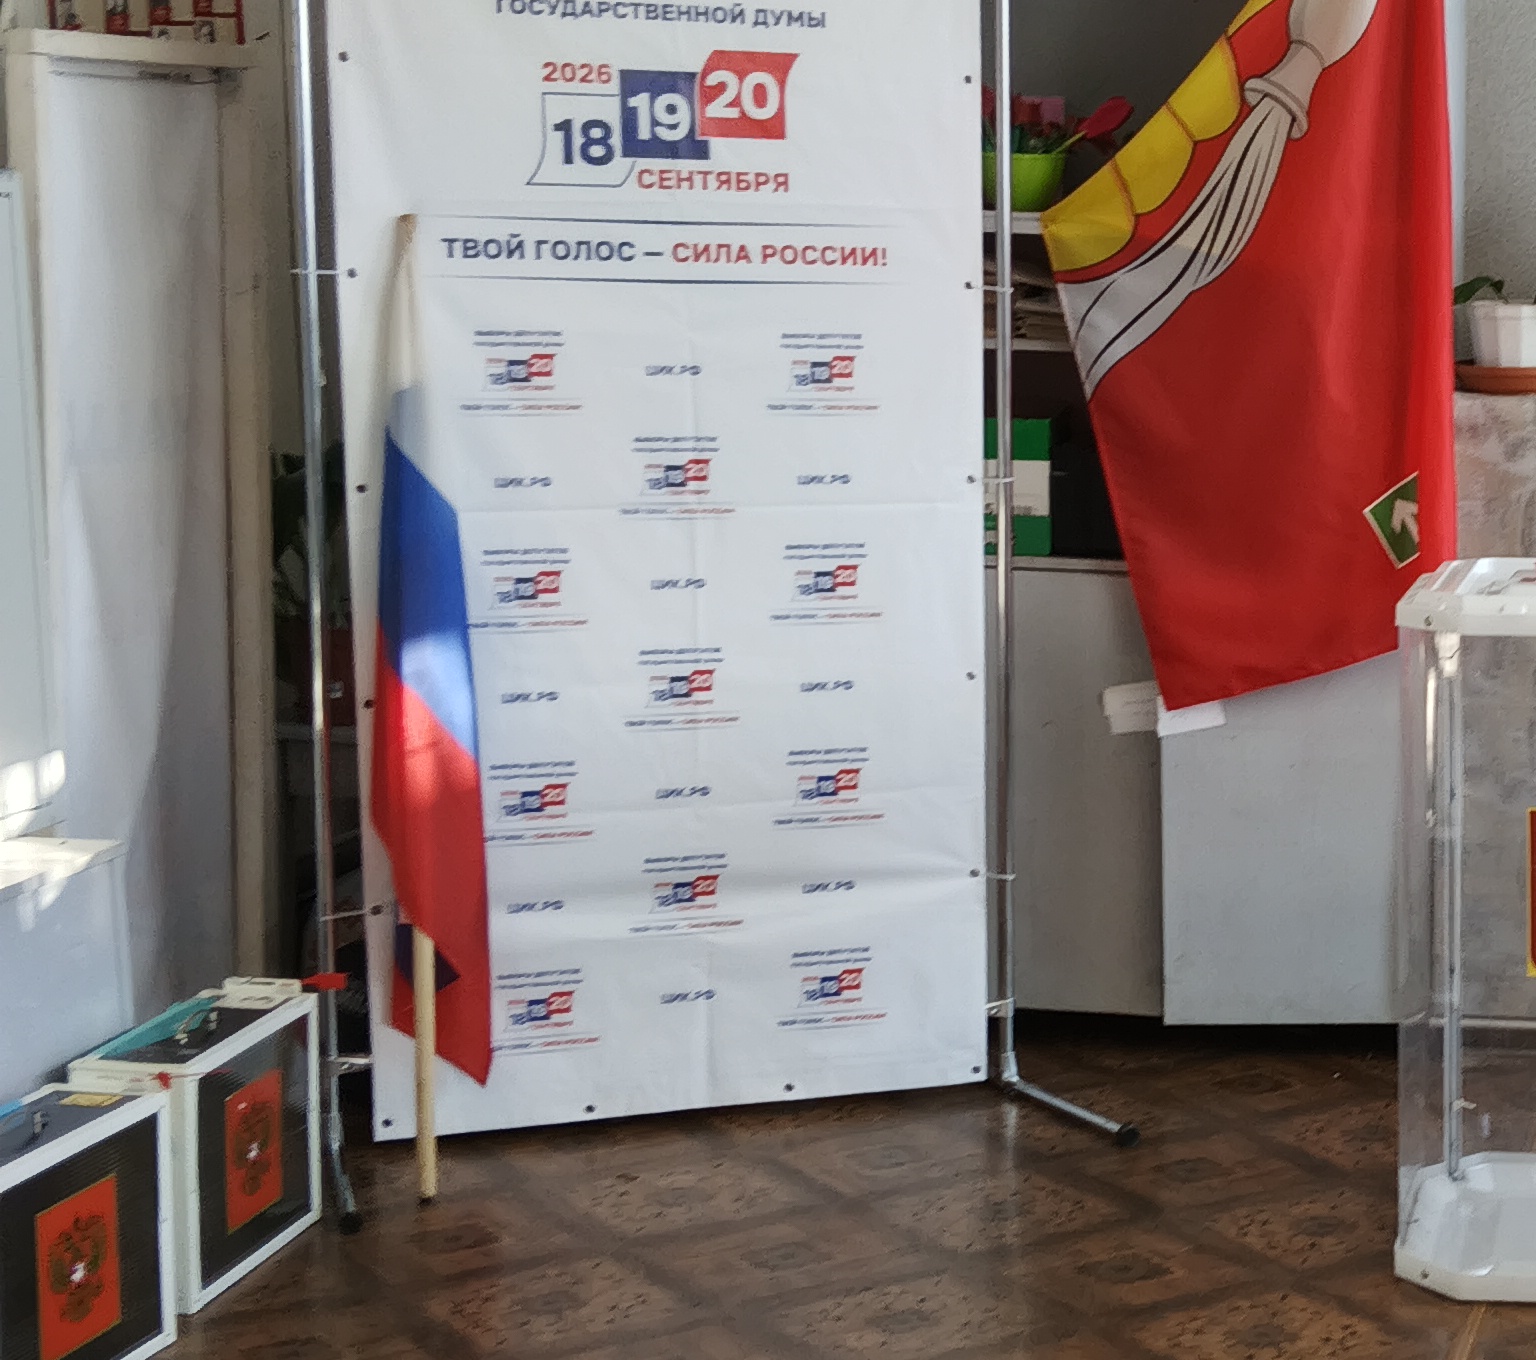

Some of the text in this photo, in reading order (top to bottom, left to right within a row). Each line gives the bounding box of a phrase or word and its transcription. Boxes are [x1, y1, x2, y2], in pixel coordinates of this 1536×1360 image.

[752, 9, 825, 28] ДУМЫ
[542, 62, 611, 84] 2026
[705, 70, 780, 119] 20
[627, 93, 691, 141] 19
[553, 119, 615, 166] 18
[637, 169, 789, 192] СЕНТЯБРЯ
[441, 233, 525, 259] ТВОЙ
[534, 240, 635, 262] ГОЛОС
[672, 243, 752, 264] СИЛА
[761, 245, 887, 266] РОССИИ!
